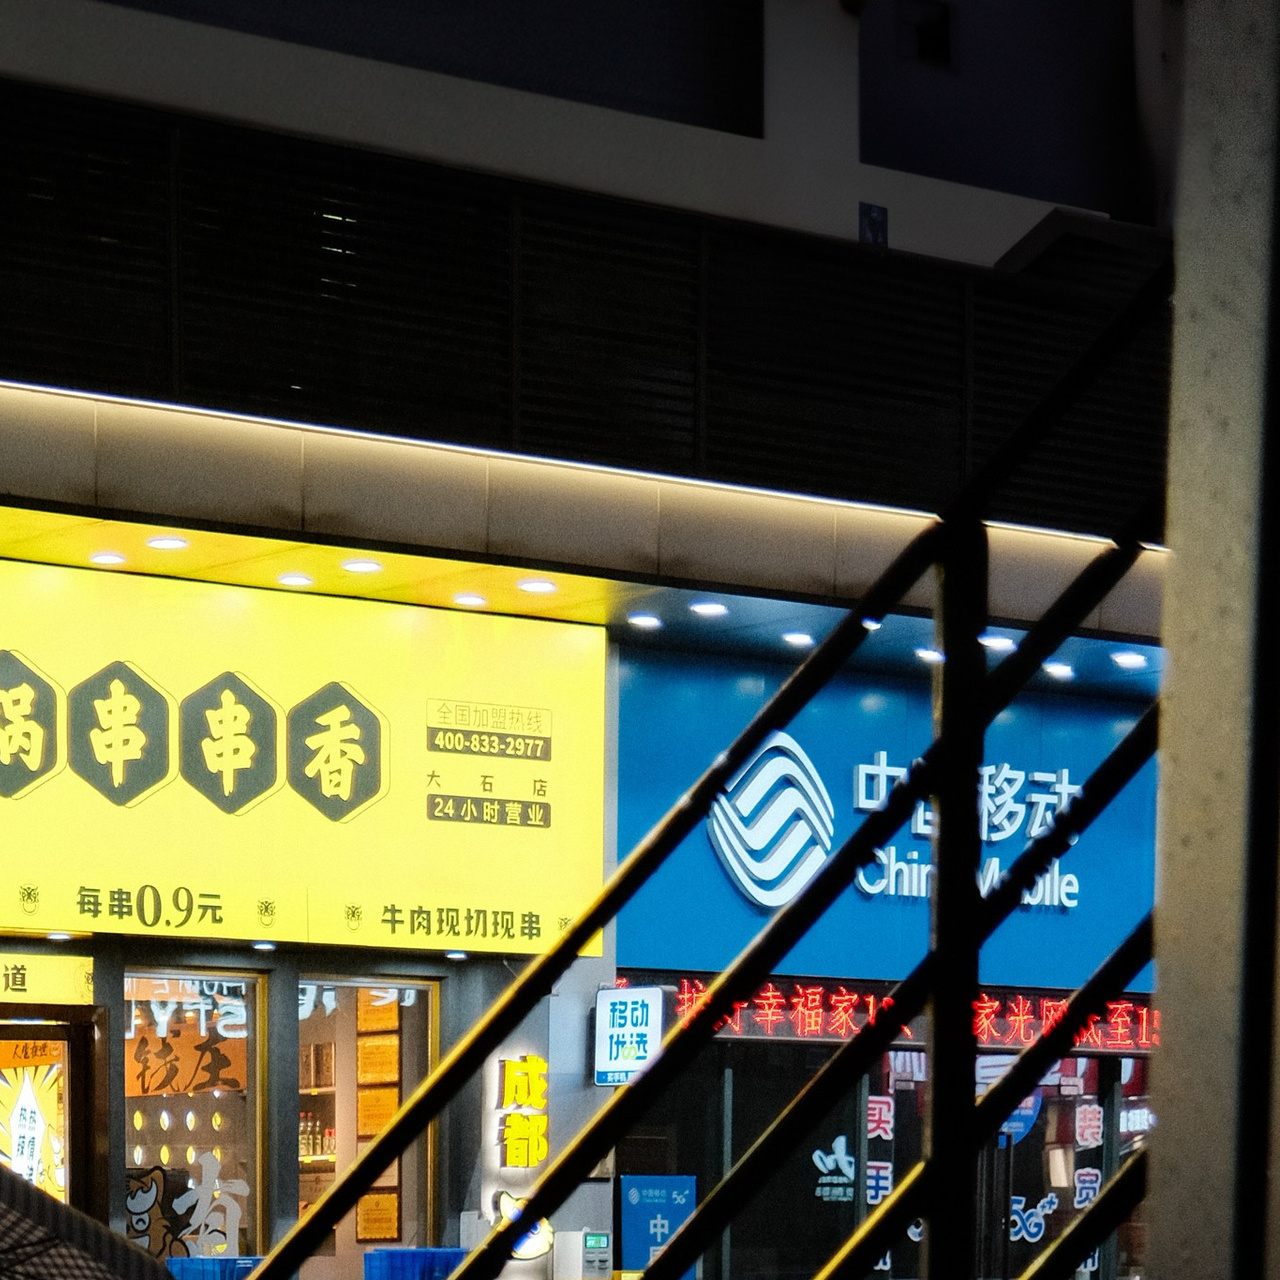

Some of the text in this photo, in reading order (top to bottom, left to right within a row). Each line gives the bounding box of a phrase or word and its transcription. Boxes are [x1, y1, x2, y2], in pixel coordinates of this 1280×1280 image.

[436, 702, 543, 734] 全国加盟热线
[434, 730, 544, 757] 400-833-2977
[426, 769, 548, 798] 大石店
[853, 750, 1084, 845] 中移动
[433, 797, 545, 826] 24小时营业
[76, 884, 224, 928] 每串0.9元
[381, 904, 543, 942] 牛肉现切现串
[609, 999, 649, 1029] 移动
[608, 1032, 648, 1061] 优选
[498, 1055, 549, 1168] 成都
